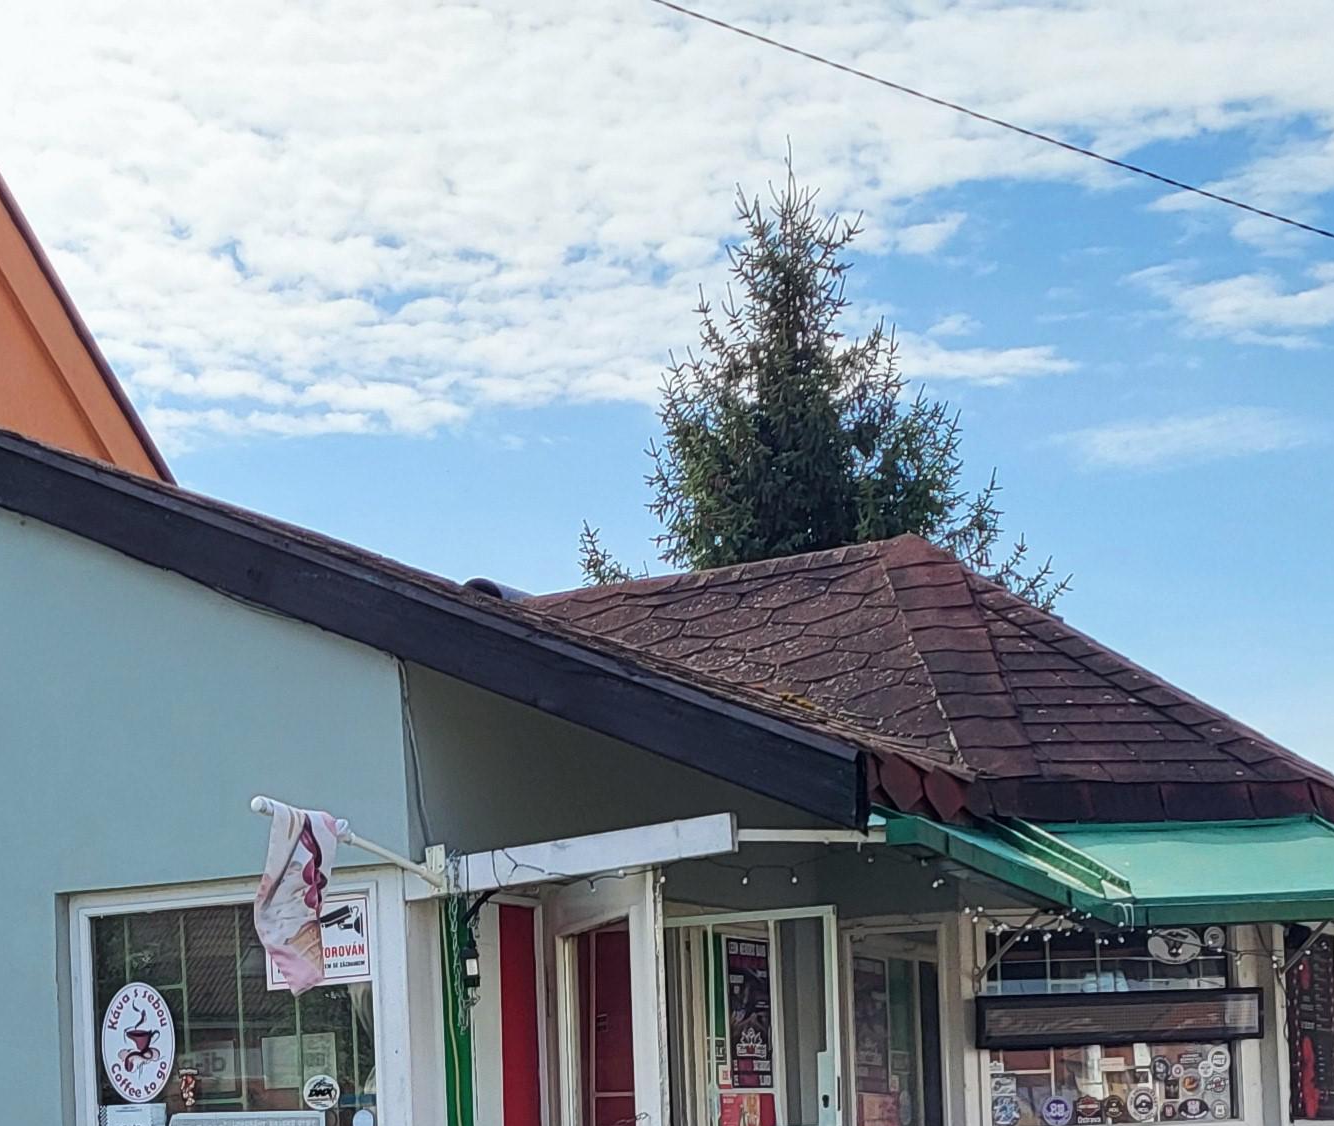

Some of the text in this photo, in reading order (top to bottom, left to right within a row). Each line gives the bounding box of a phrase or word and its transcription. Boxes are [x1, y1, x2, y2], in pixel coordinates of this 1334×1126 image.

[107, 994, 130, 1030] Káva
[142, 990, 167, 1027] sebou
[111, 1063, 141, 1098] Coffee
[144, 1081, 157, 1095] to
[156, 1061, 167, 1080] go
